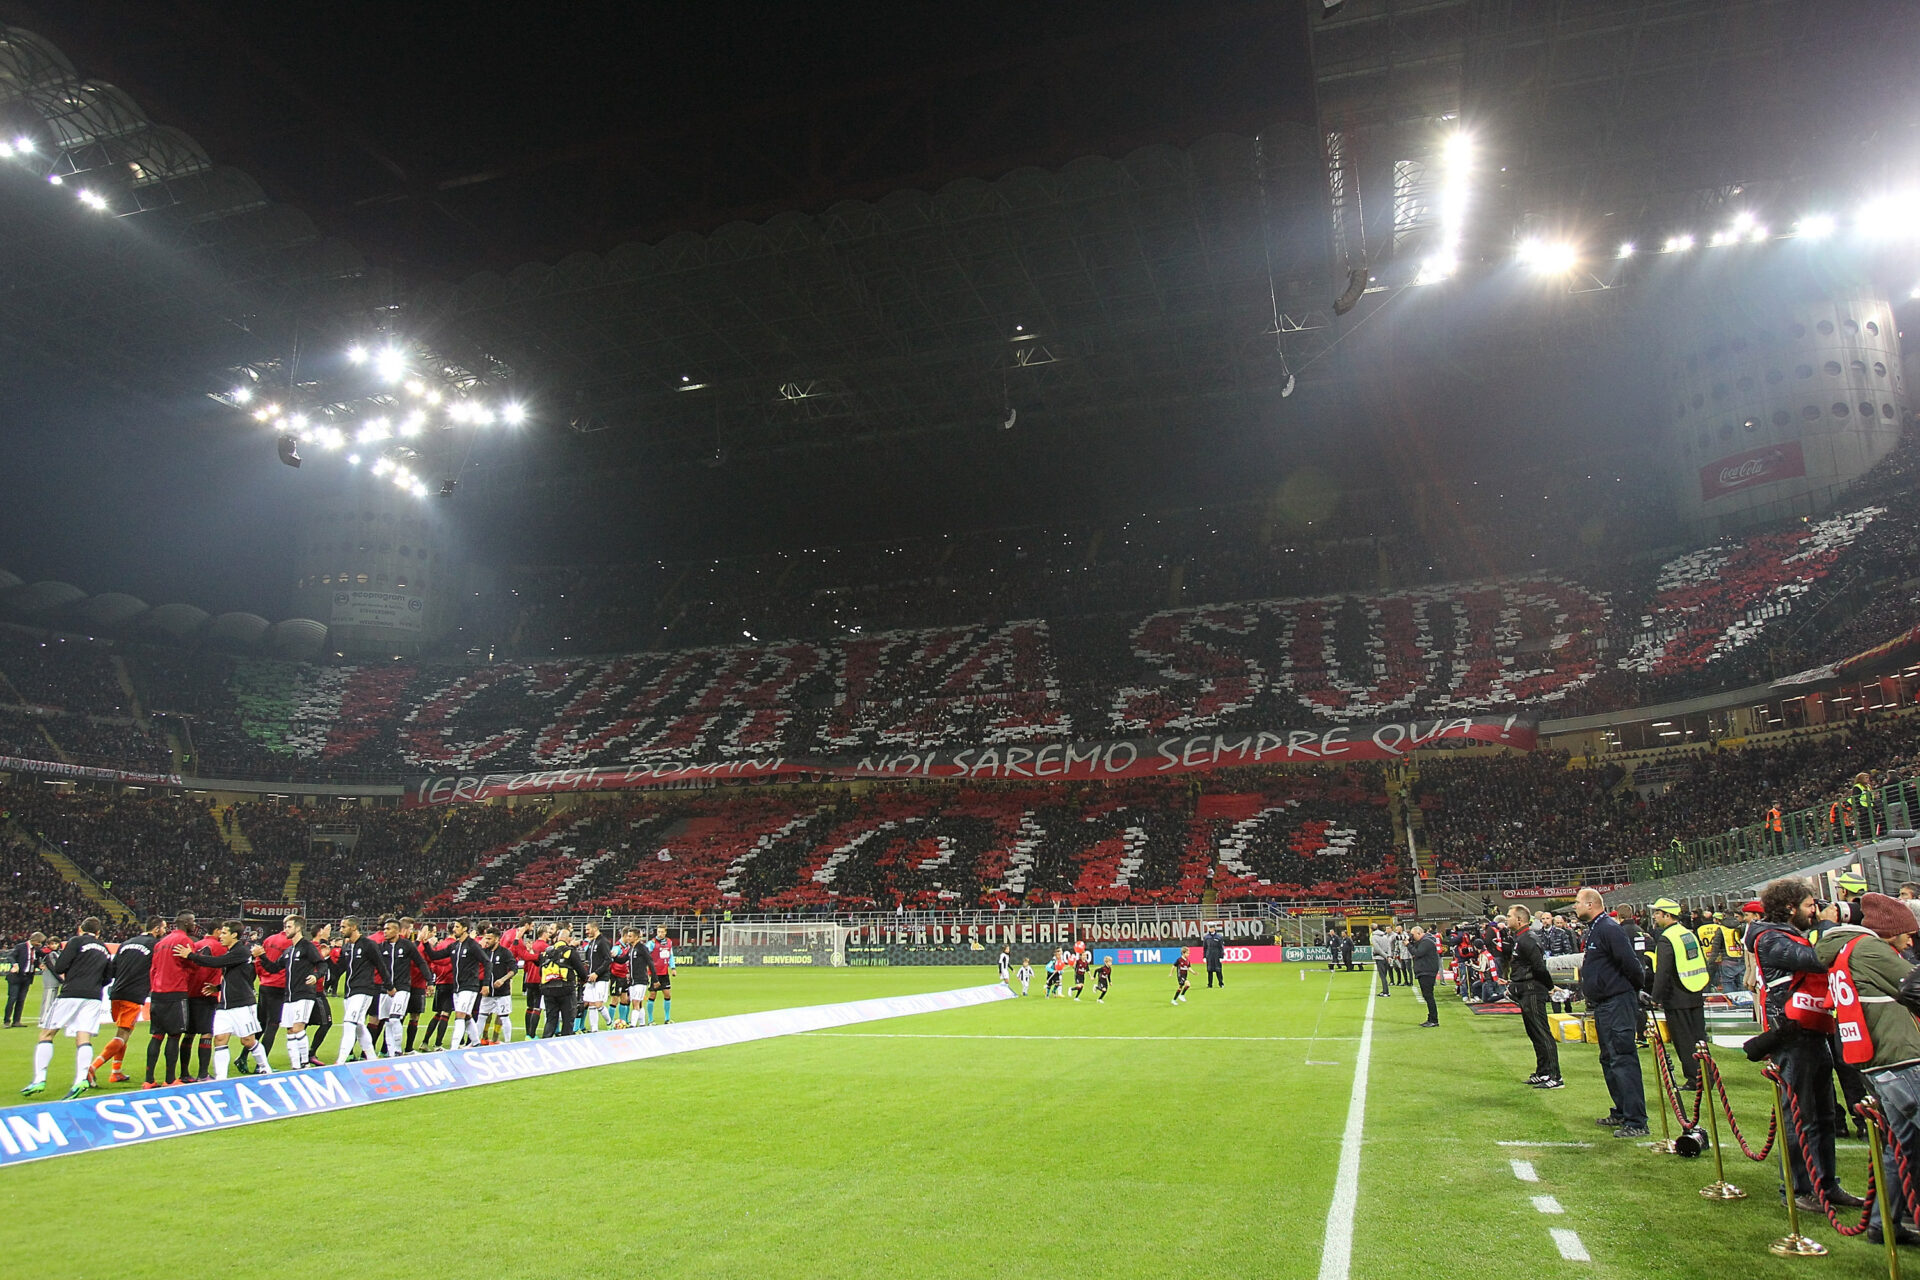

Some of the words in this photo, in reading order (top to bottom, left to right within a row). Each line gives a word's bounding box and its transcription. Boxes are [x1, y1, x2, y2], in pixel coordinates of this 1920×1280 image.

[951, 742, 1138, 777] SAREMO
[1156, 727, 1350, 771] SEMPRE
[1372, 717, 1473, 755] QUA
[708, 955, 744, 964] WELCOME
[763, 955, 813, 964] BIENVENIDOS
[1134, 950, 1161, 962] TIM
[392, 1003, 402, 1014] 12
[1796, 996, 1823, 1009] RIC
[463, 1046, 541, 1081] SERIE
[550, 1036, 606, 1067] TIM
[392, 1058, 457, 1090] TIM
[96, 1089, 241, 1140] SERIE
[235, 1083, 278, 1119] A
[258, 1070, 352, 1113] TIM
